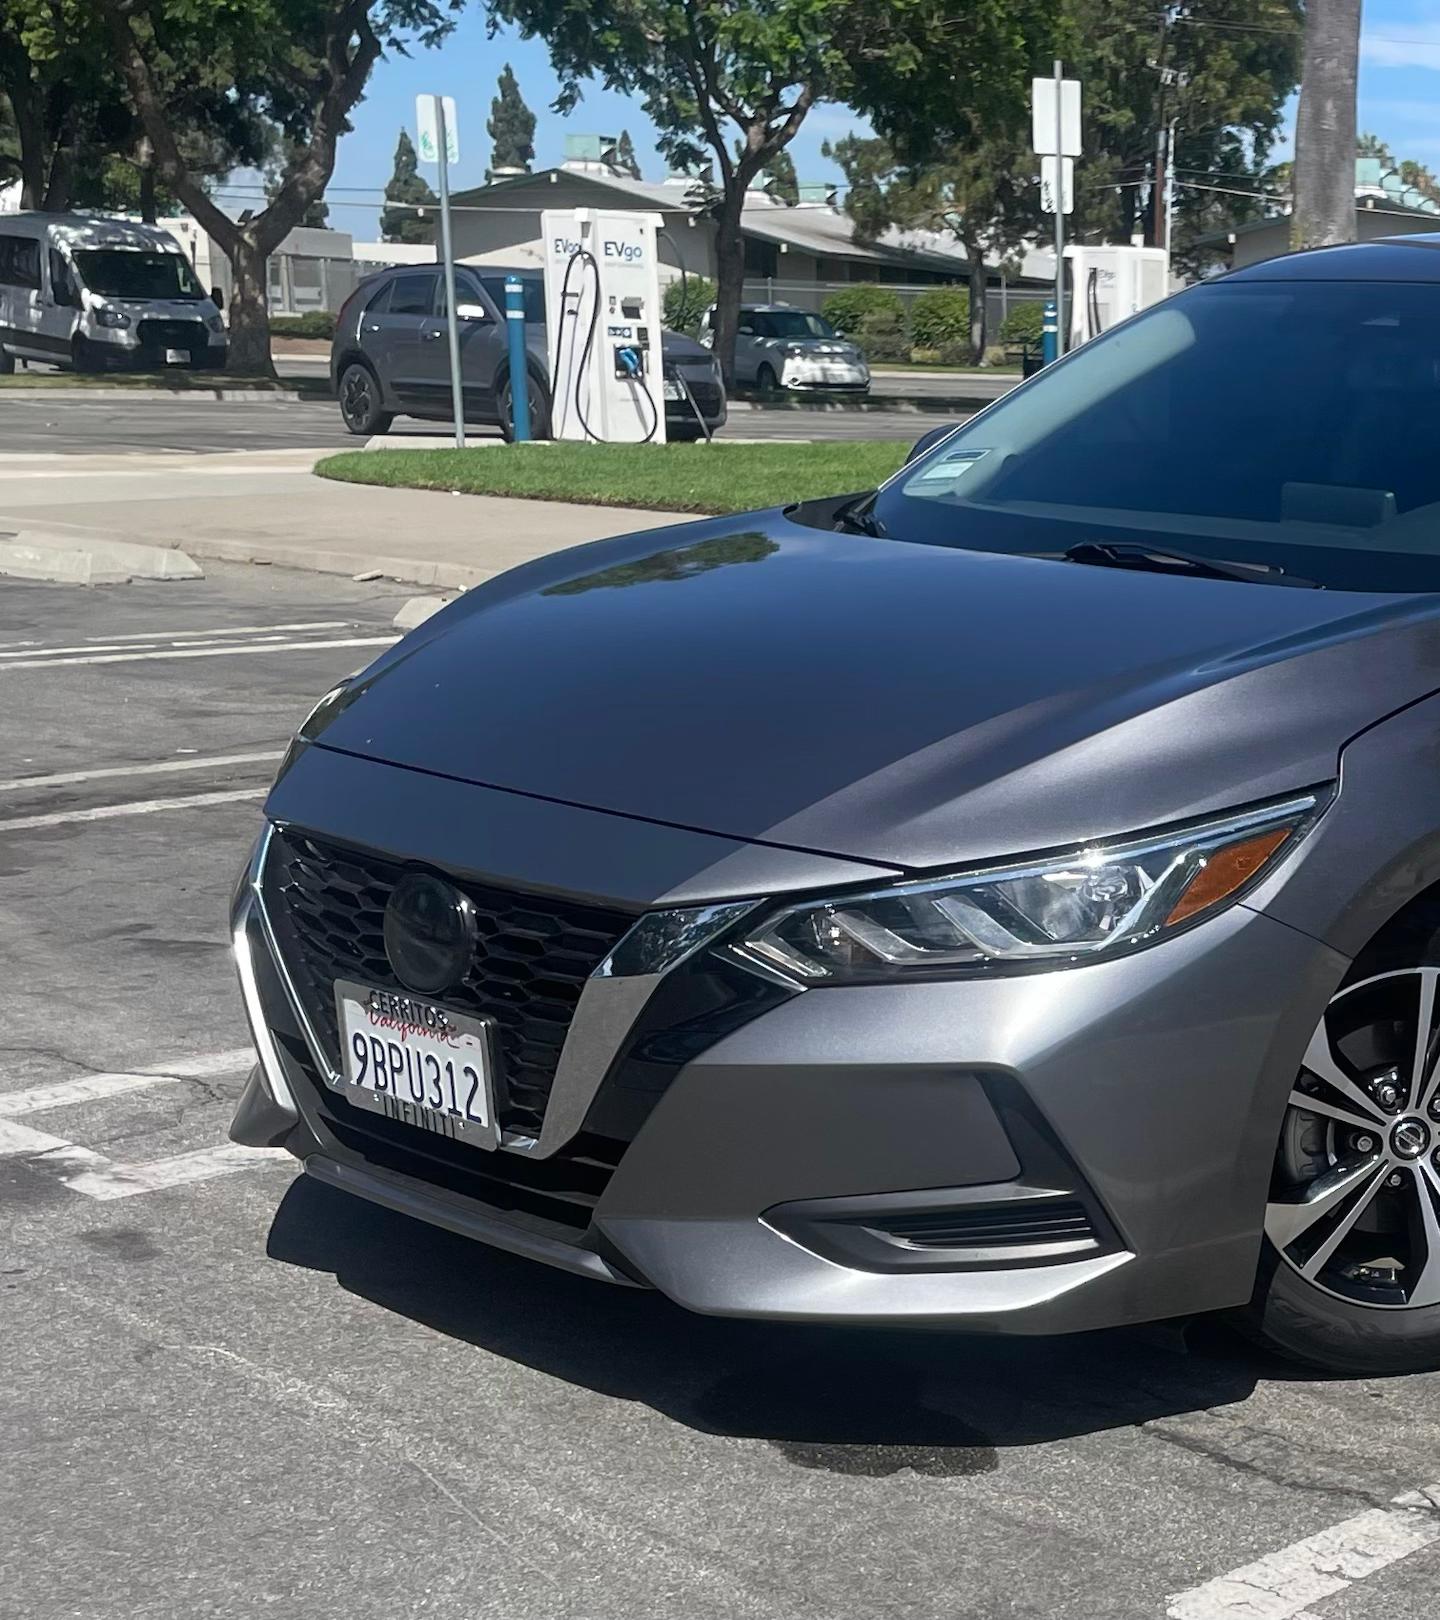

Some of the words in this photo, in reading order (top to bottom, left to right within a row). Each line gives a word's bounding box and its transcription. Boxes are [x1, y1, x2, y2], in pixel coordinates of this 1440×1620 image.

[604, 241, 642, 261] EVgo
[369, 990, 450, 1029] CERRITOS
[352, 1032, 482, 1125] 9BPU312
